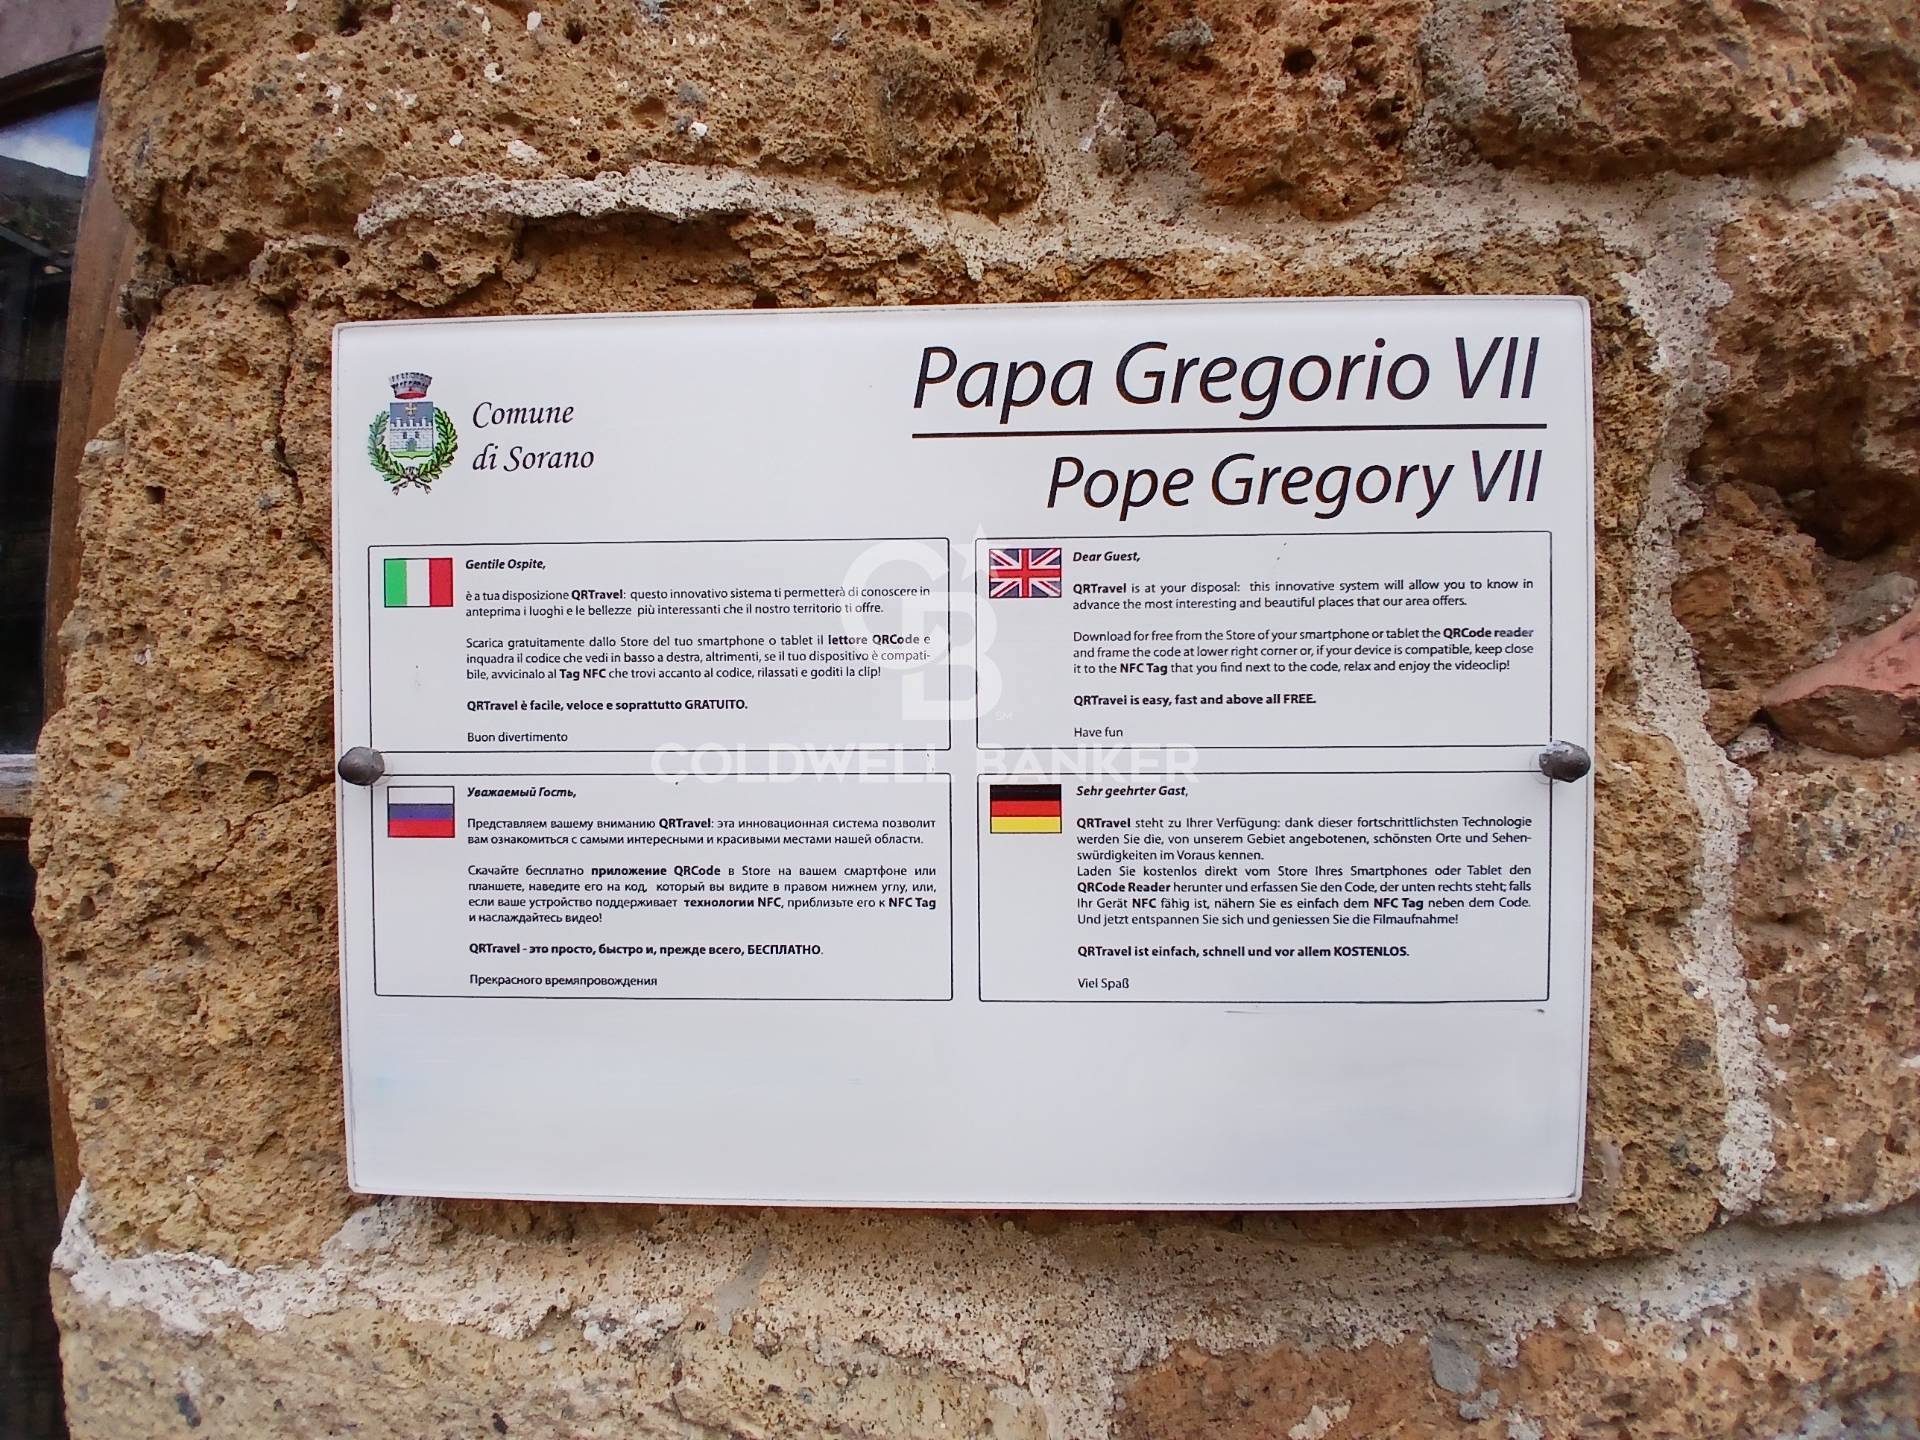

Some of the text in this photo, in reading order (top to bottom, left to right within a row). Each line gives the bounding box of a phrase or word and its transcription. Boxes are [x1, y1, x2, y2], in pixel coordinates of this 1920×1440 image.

[913, 336, 1540, 426] Papa Gregorio VII
[472, 399, 574, 429] Comune
[472, 442, 595, 472] di Sorano
[1047, 449, 1543, 523] Pope Gregory VII
[1072, 550, 1141, 563] Dear Guest,
[465, 558, 546, 572] Gentile Ospite,
[1072, 578, 1534, 596] QRTravel is at your disposal: this innovative system will allow you to know in
[1072, 594, 1467, 612] advance the most interesting and beautiful places that our area offers.
[466, 633, 931, 651] Scarica gratuitamente dallo Store del tuo smartphone o tablet il lettore QRCode e
[466, 665, 881, 682] bile, avvicinalo al Tag NFC che trovi accanto al codice, rilassati e goditi la clip!
[466, 699, 748, 713] QRTravel è facile, veloce e soprattutto GRATUITO.
[1073, 693, 1317, 708] QRTravel is easy, fast and above all FREE.
[467, 731, 568, 743] Buon divertimento
[1074, 726, 1124, 738] Have fun
[467, 786, 577, 799] Уважаемый Гость,
[1076, 785, 1188, 799] Sehr geehrter Gast,
[467, 817, 936, 832] Представляем вашему вниманию QRTravel: эта инновационная система позволит
[1076, 815, 1533, 831] QRTravel steht zu Ihrer Verfügung: dank dieser fortschrittlichsten Technologie
[467, 833, 924, 847] вам ознакомиться с самыми интересными и красивыми местами нашей области.
[1076, 849, 1265, 863] swürdigkeiten im Voraus kennen.
[468, 912, 602, 925] и наслаждайтесь видео!
[469, 943, 521, 955] QRTravel
[529, 946, 549, 954] это
[551, 945, 597, 957] просто,
[598, 943, 644, 957] быстро
[645, 946, 657, 956] и,
[659, 946, 707, 957] прежде
[708, 946, 745, 957] всего,
[747, 944, 824, 955] БЕСПЛАТНО.
[1077, 945, 1410, 958] QRTravel ist einfach, schnell und vor allem KOSTENLOS.
[469, 974, 658, 988] Прекрасного времяпровождения
[1077, 977, 1130, 991] Viel Spaß
